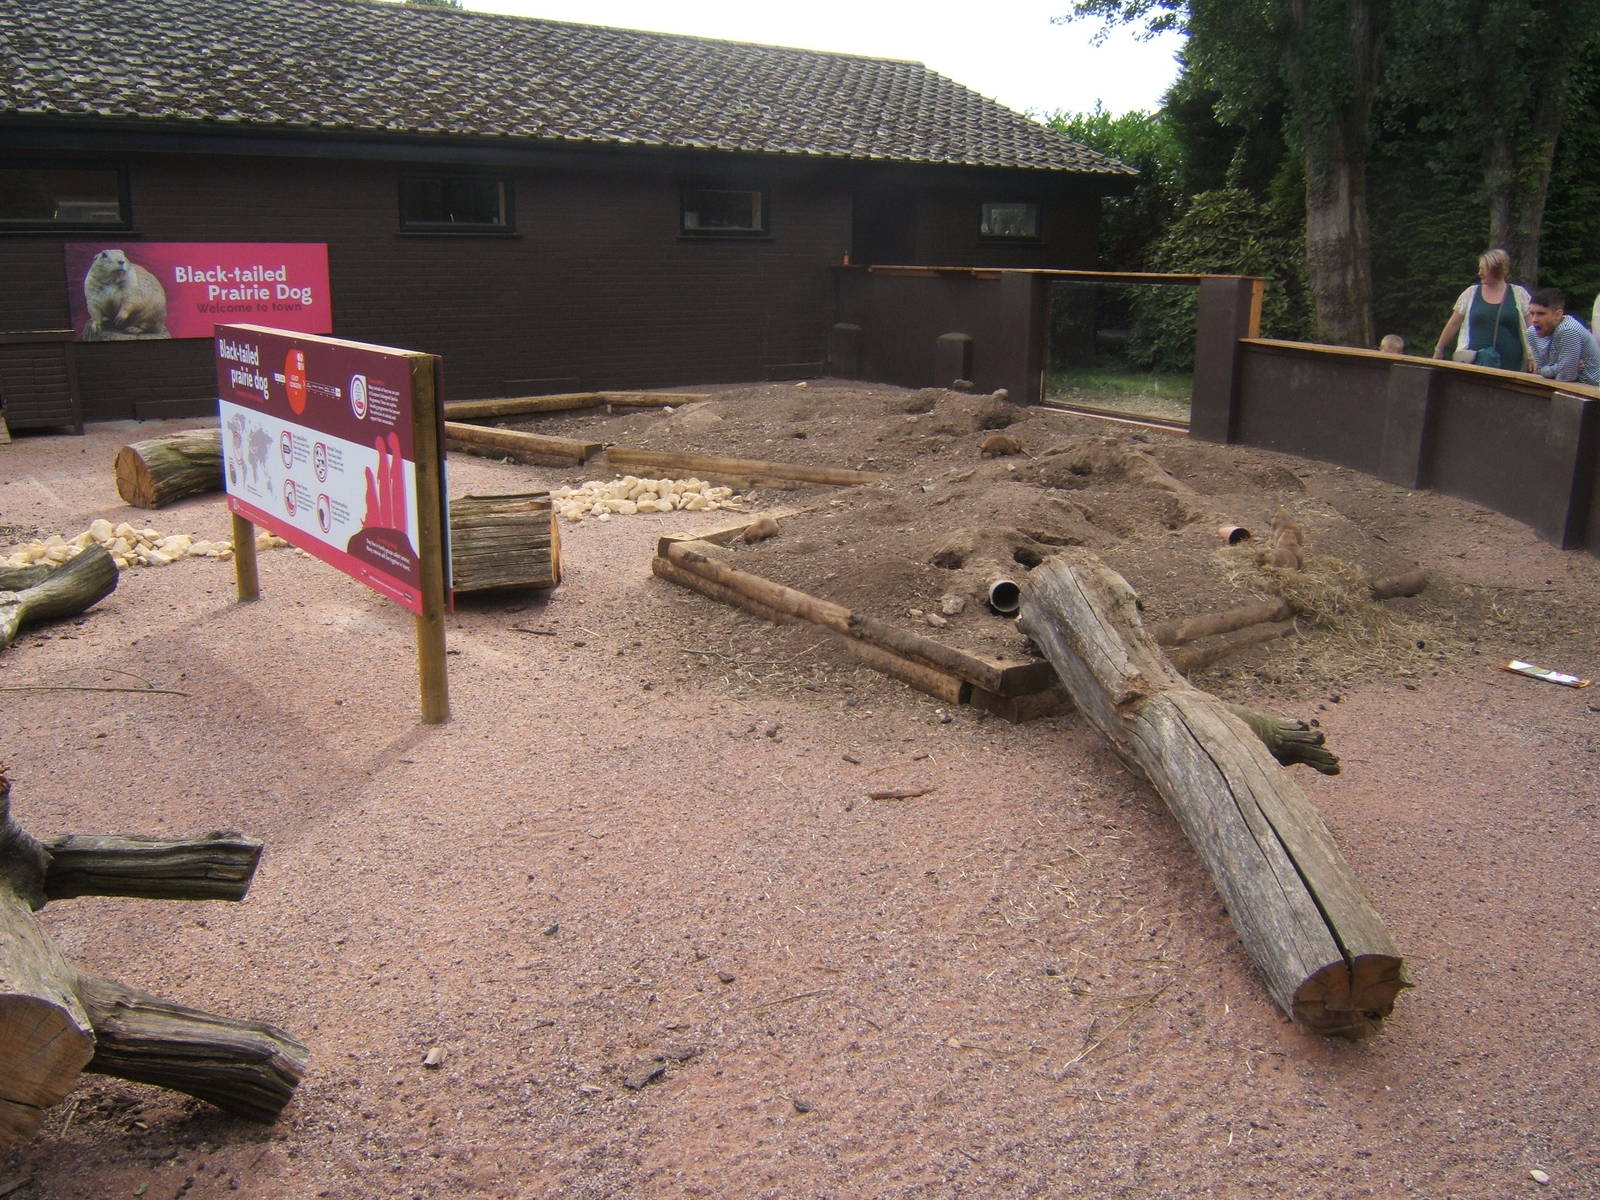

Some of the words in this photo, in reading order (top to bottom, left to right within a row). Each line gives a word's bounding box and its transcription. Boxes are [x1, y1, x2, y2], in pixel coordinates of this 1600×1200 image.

[175, 265, 287, 283] Black-tailed
[208, 284, 270, 301] Prairie
[276, 284, 313, 305] Dog
[196, 302, 253, 313] Welcome
[256, 302, 269, 312] to
[272, 302, 302, 312] town
[219, 338, 260, 366] Black-tailed
[231, 366, 253, 389] prairie
[254, 368, 270, 400] dog
